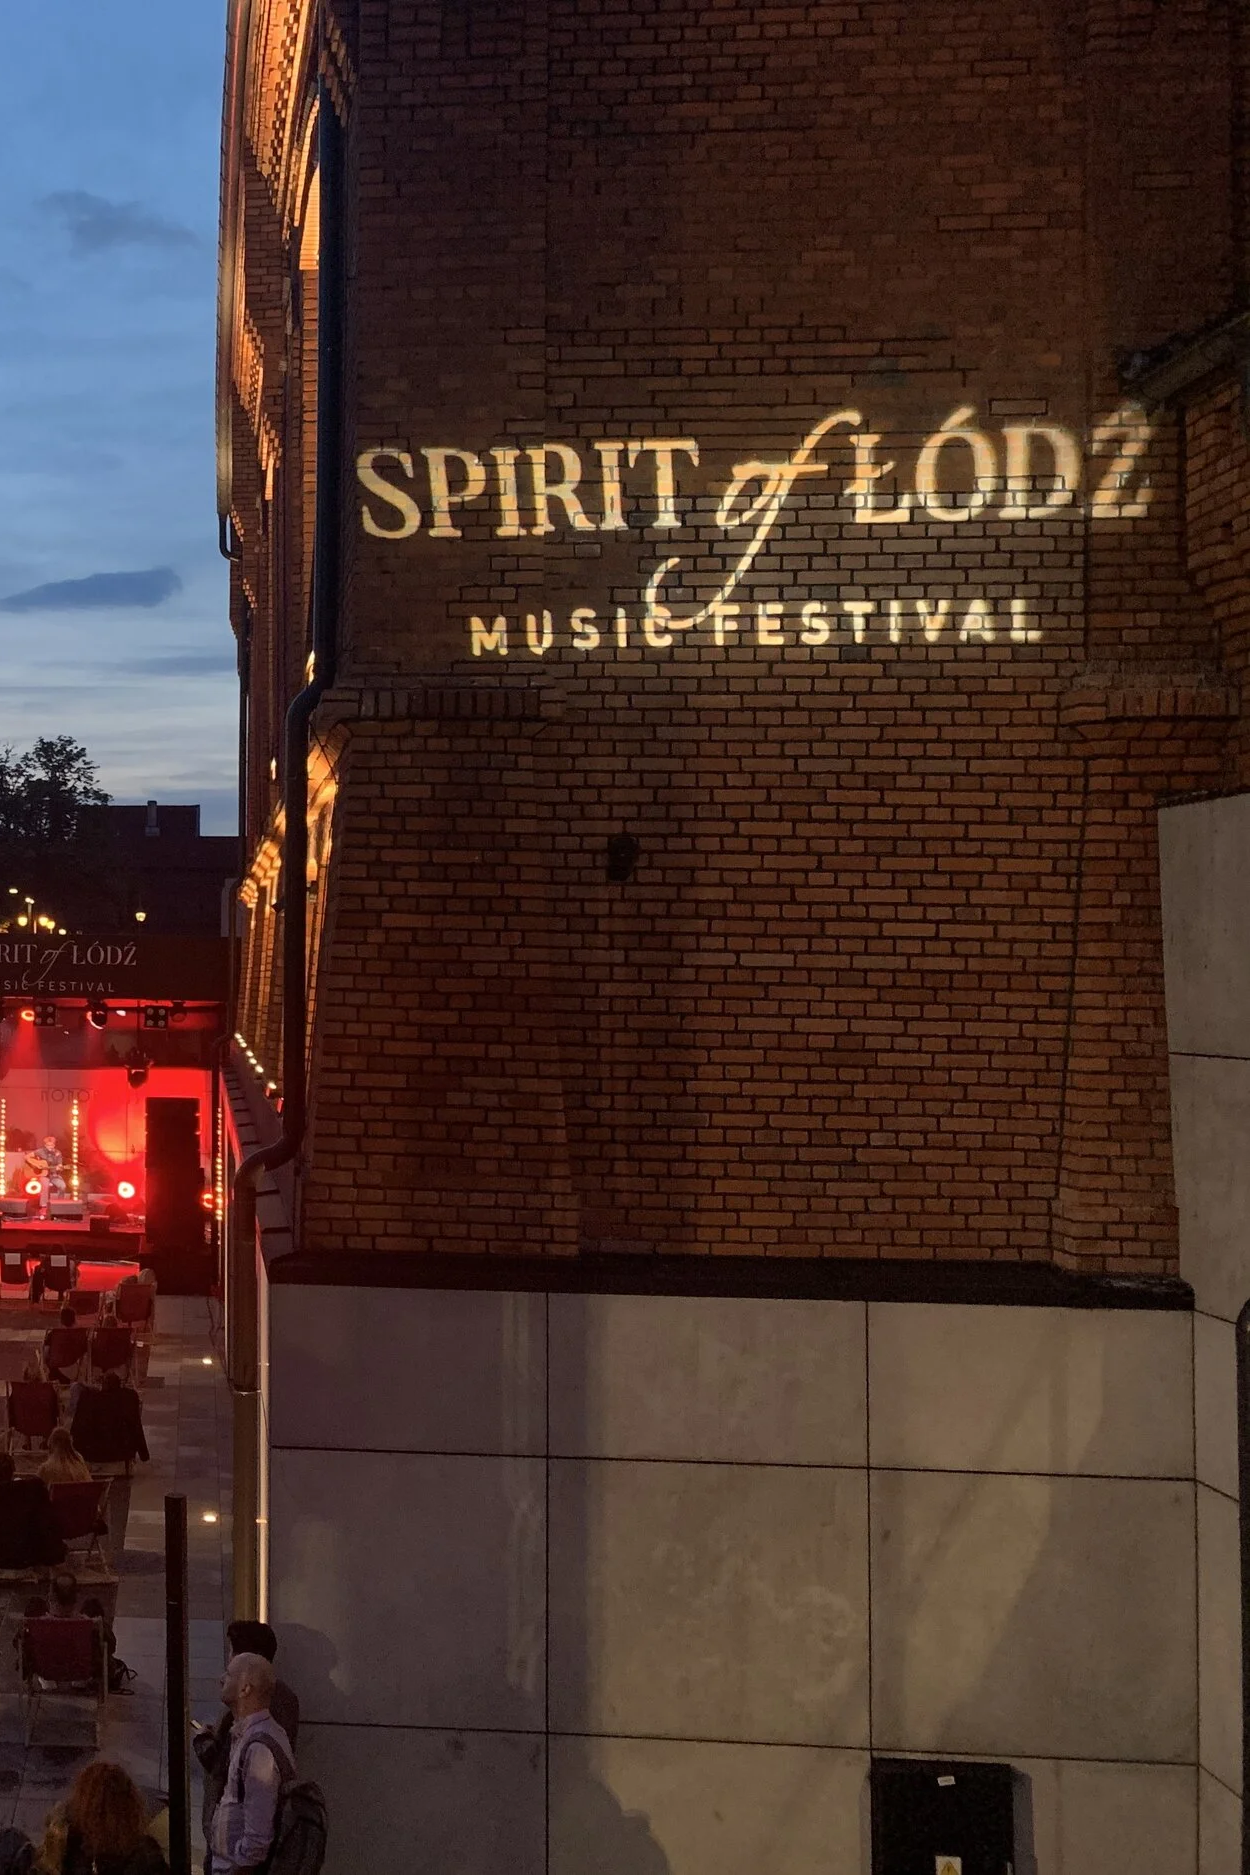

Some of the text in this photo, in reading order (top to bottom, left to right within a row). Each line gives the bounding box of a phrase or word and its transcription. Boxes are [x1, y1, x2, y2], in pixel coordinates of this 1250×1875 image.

[355, 401, 1156, 630] SPIRIT of ŁÓDŹ
[468, 598, 1045, 657] MUSIC FESTIVAL
[21, 940, 77, 986] of
[37, 980, 116, 993] FESTIVAL
